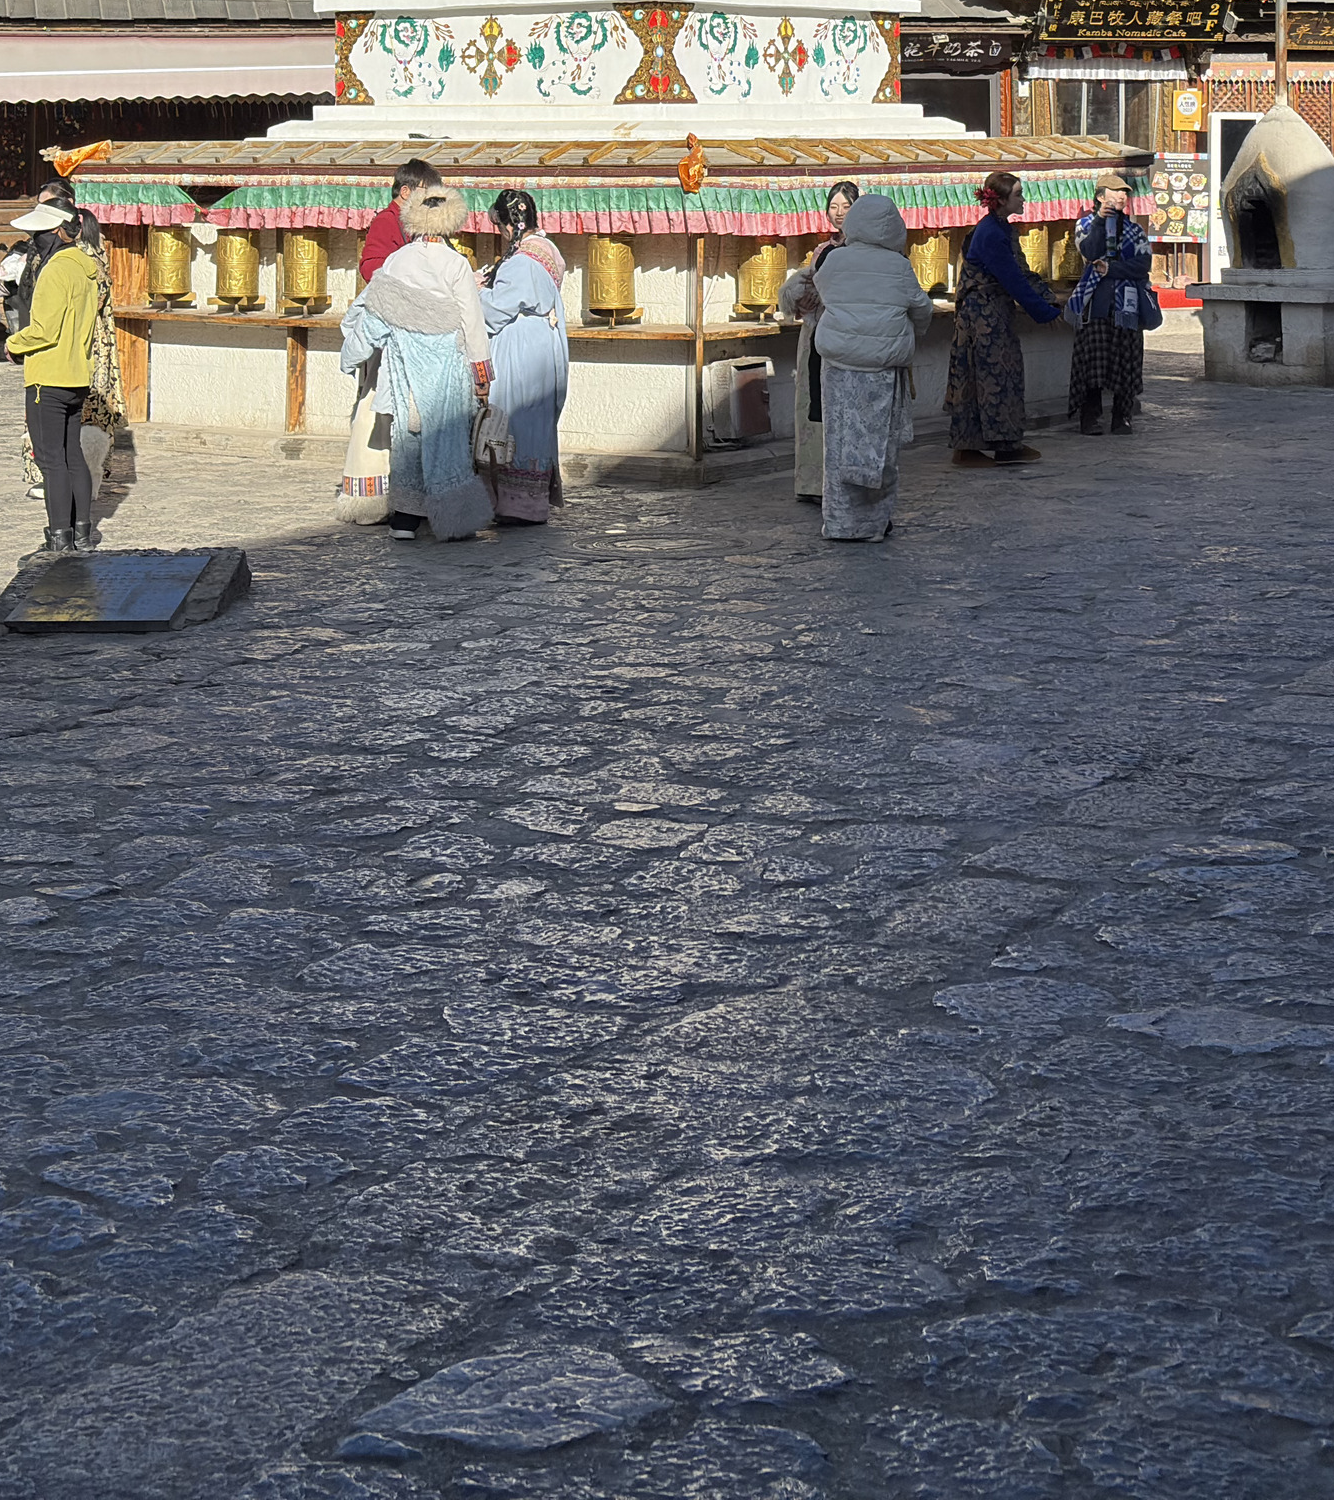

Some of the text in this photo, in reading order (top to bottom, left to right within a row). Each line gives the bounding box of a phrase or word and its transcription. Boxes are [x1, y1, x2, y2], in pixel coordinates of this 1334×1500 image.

[1067, 10, 1203, 26] 康巴牧人藏餐吧
[1077, 29, 1187, 38] Kamba Nomadic Cafe
